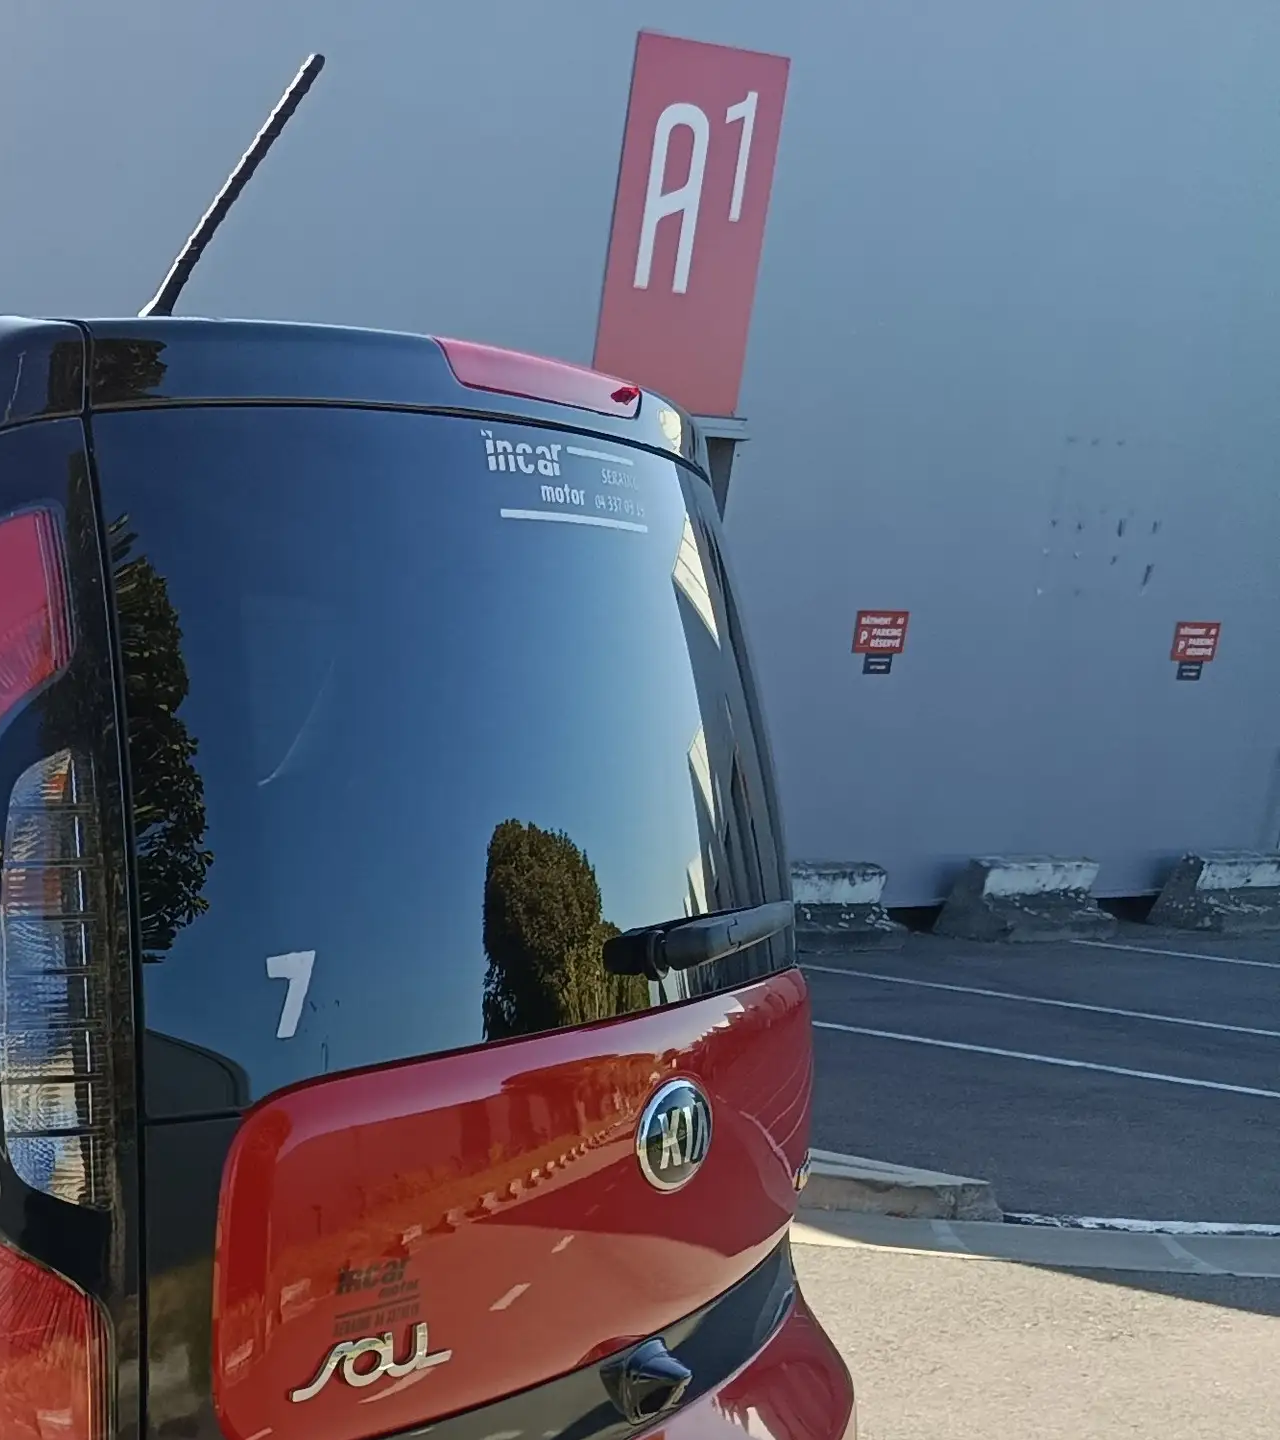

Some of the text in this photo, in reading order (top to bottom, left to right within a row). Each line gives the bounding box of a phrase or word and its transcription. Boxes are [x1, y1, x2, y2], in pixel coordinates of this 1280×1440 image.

[633, 91, 758, 294] A1
[480, 429, 561, 476] incar
[541, 483, 585, 505] motor
[860, 630, 868, 644] P
[266, 949, 316, 1038] 7
